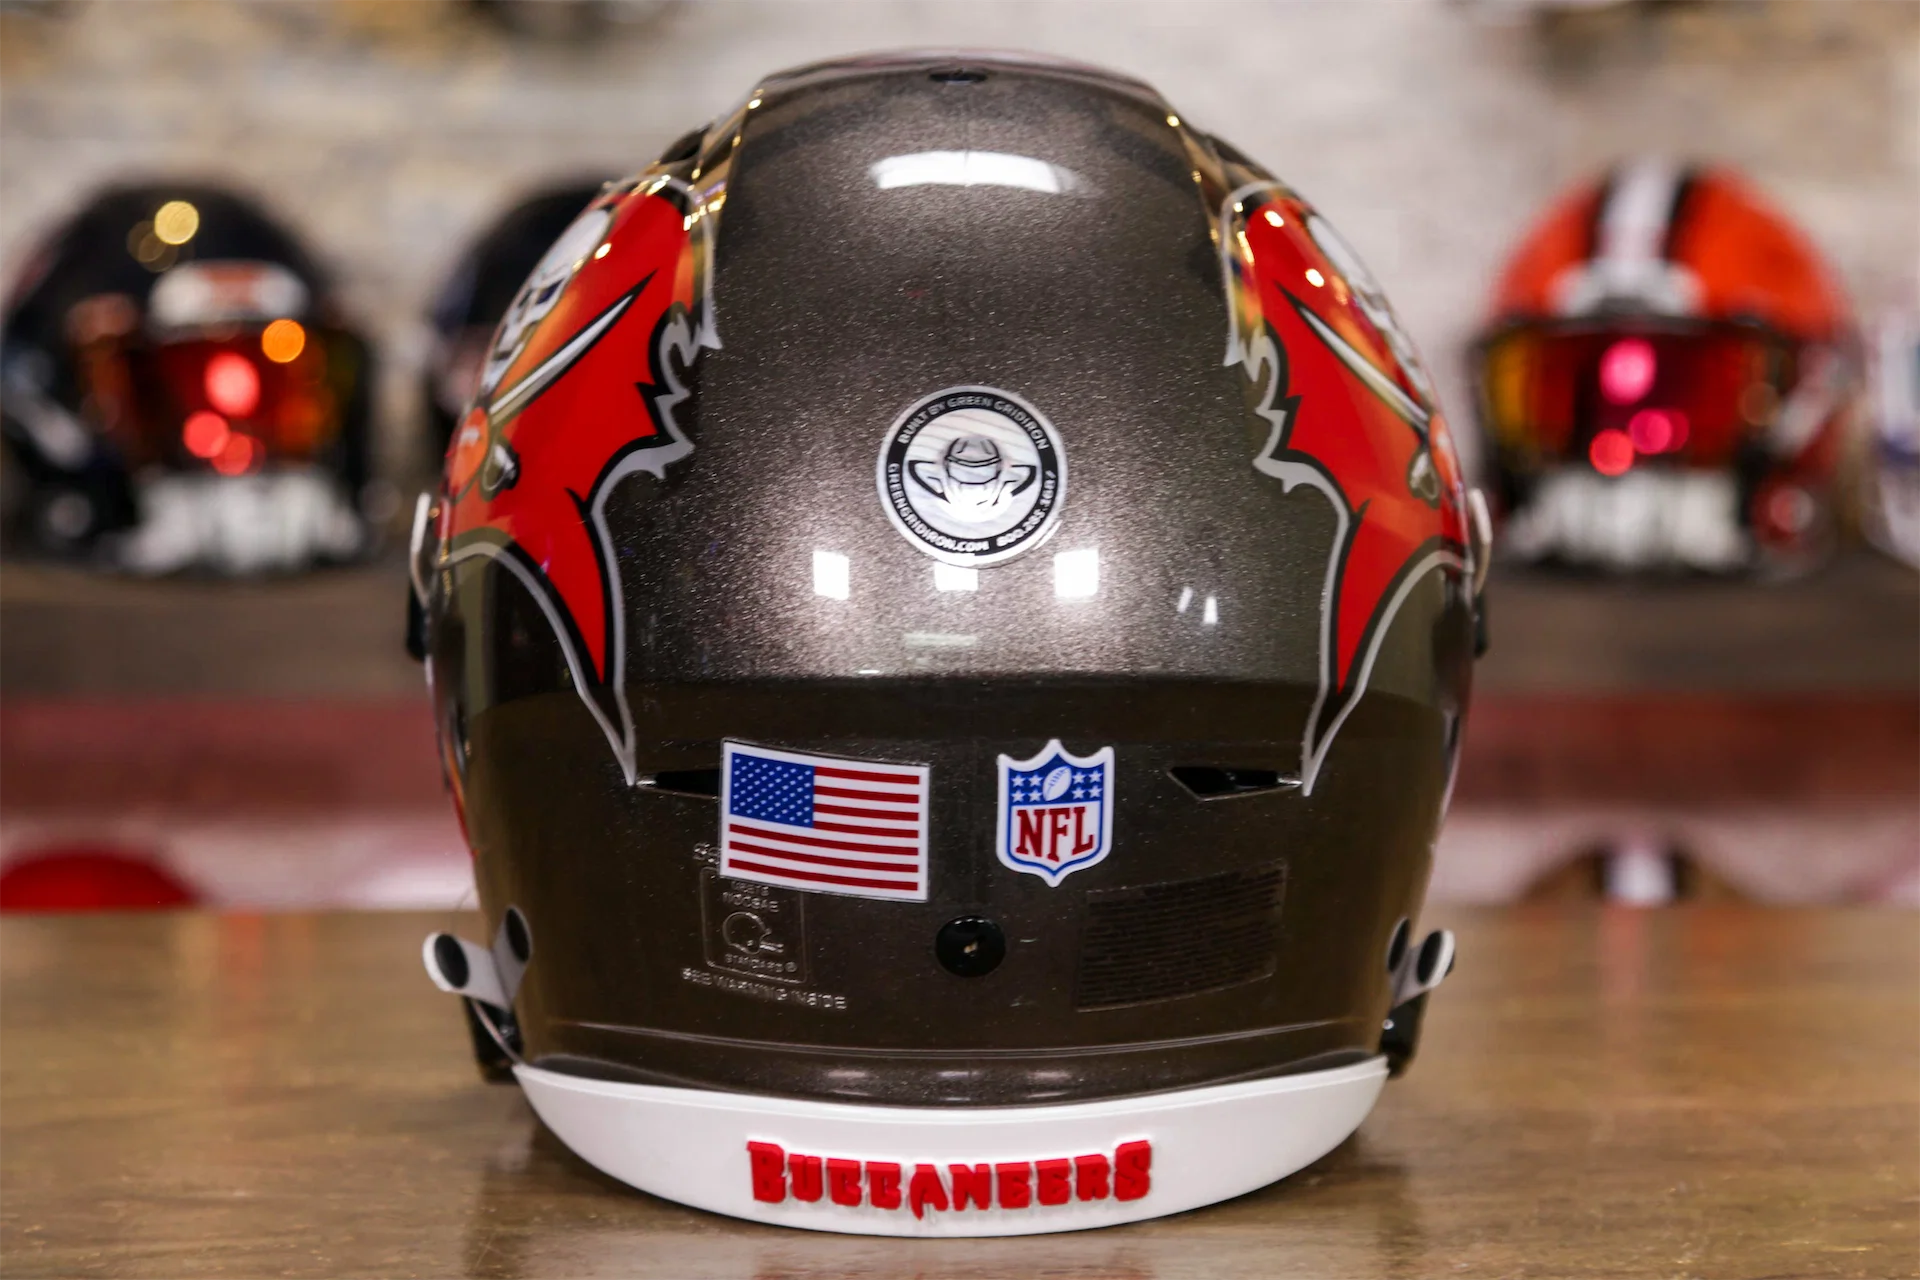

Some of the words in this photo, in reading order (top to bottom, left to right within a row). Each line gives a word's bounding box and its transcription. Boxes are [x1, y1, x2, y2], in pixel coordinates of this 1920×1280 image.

[897, 412, 929, 444] BUILT
[928, 402, 946, 416] BY
[947, 396, 994, 408] GREEN
[993, 400, 1050, 450] GRIDIRON
[1015, 806, 1094, 863] NFL
[747, 1140, 1152, 1221] BUCCANEERS
